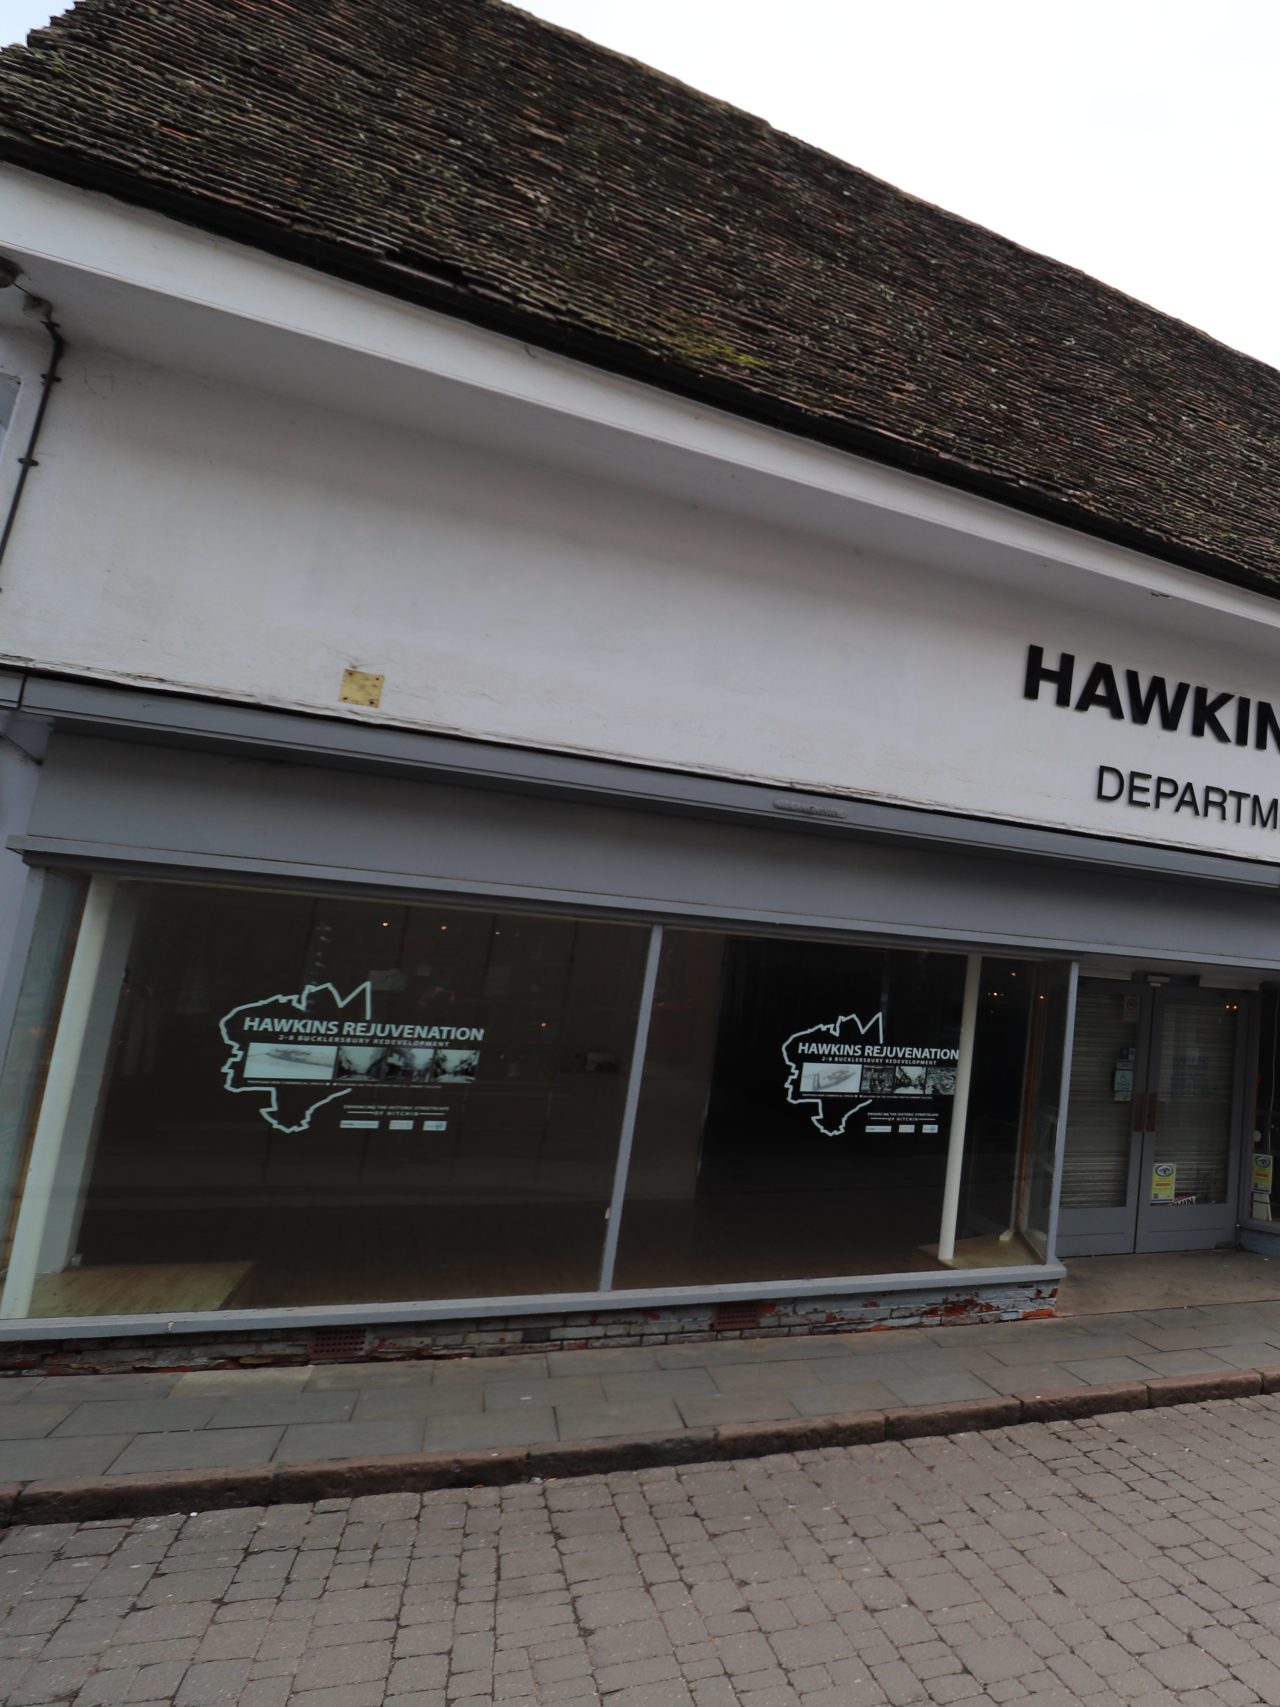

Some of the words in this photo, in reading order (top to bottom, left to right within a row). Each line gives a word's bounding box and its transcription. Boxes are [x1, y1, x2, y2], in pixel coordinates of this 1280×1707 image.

[243, 1017, 339, 1034] HAWKINS
[342, 1021, 485, 1041] REJUVENATION
[798, 1042, 862, 1056] HAWKINS
[864, 1045, 960, 1060] REJUVENATION
